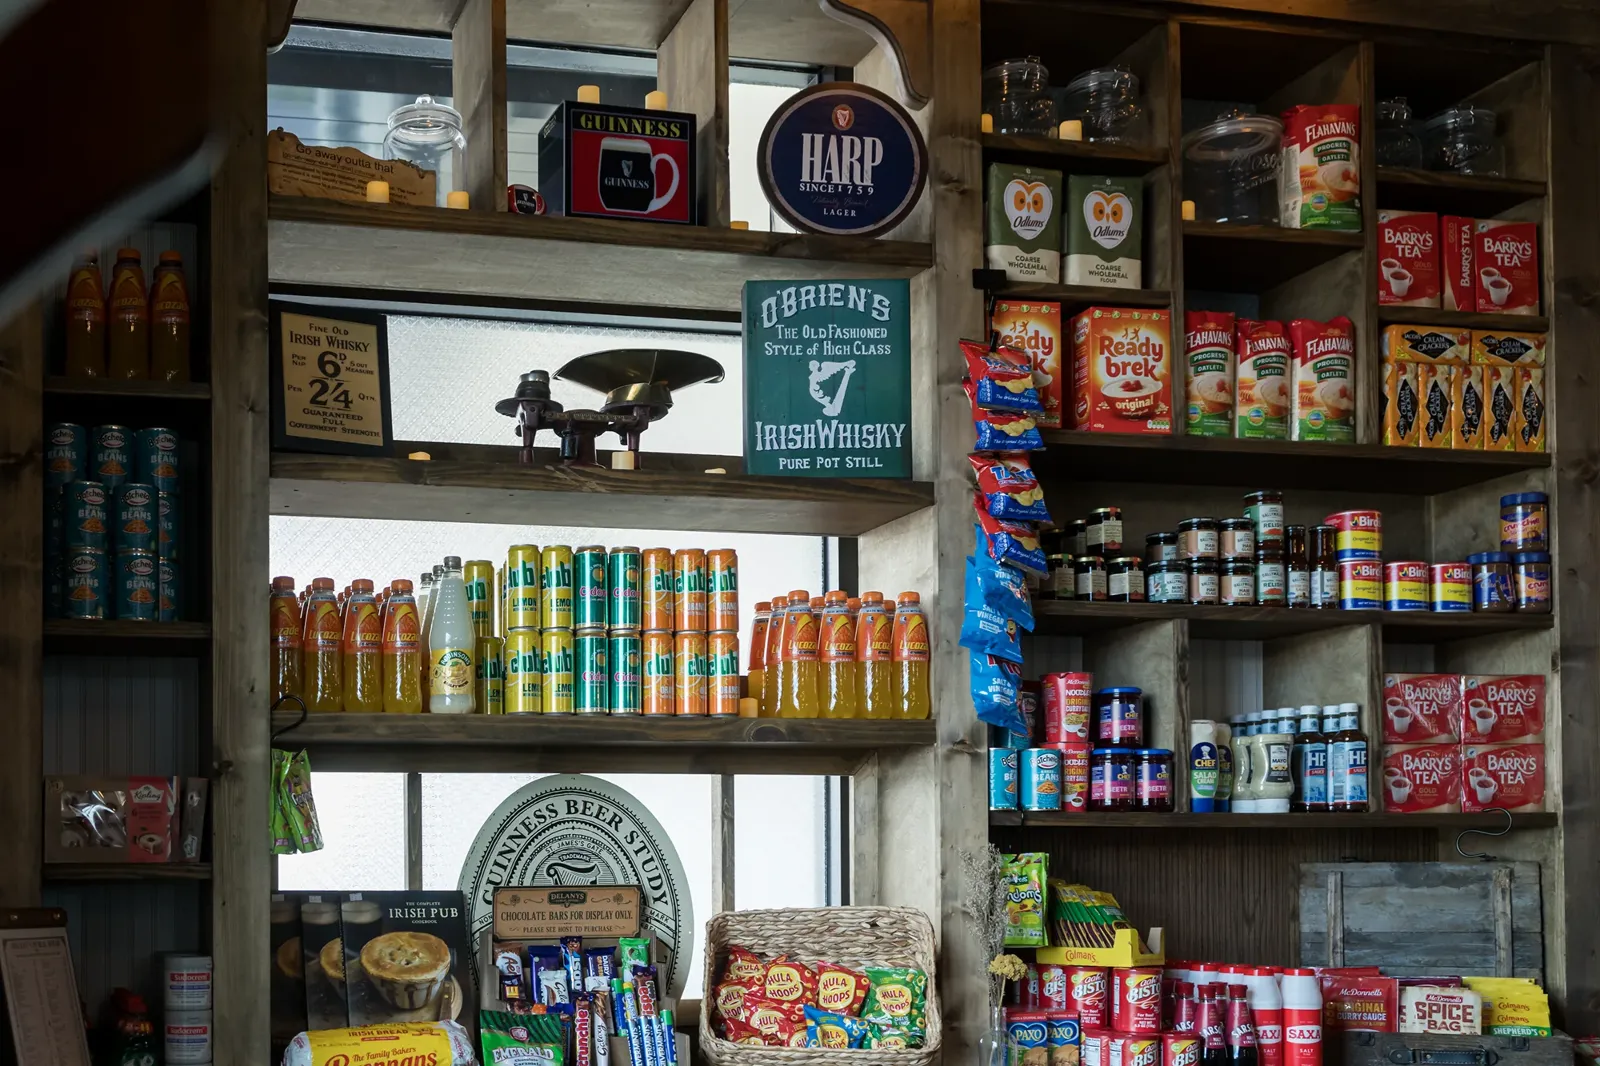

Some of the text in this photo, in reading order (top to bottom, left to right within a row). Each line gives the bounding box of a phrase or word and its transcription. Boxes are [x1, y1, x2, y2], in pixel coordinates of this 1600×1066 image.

[580, 113, 681, 138] GUINNESS
[295, 143, 312, 155] Go
[315, 150, 342, 163] away
[344, 157, 371, 169] outta
[374, 161, 394, 174] that
[801, 133, 883, 186] HARP
[604, 176, 650, 190] GUINNESS
[799, 183, 835, 193] SINCE
[824, 208, 857, 217] LAGER
[1013, 216, 1046, 229] Odlums
[1093, 226, 1126, 239] Odlums
[1384, 228, 1433, 250] BARRY'S
[1461, 225, 1470, 246] TEA
[1395, 245, 1422, 258] TEA
[1483, 237, 1533, 259] BARRY'S
[1007, 261, 1048, 272] WHOLEMEAL
[1015, 255, 1041, 264] COARSE
[1494, 253, 1521, 267] TEA
[1088, 270, 1129, 280] WHOLEMEAL
[1095, 264, 1121, 272] COARSE
[761, 283, 891, 328] O'BRIEN'S
[309, 322, 349, 335] FINE OLD
[776, 325, 799, 339] THE
[289, 331, 371, 352] IRISH WHISKY
[1185, 330, 1232, 349] FLAHAVAN'S
[1423, 335, 1446, 344] CREAM
[1500, 341, 1521, 349] CREAM
[765, 341, 892, 355] STYLE of HIGH CLASS
[1099, 335, 1164, 363] Ready
[1417, 342, 1451, 352] CRACKERS
[1495, 347, 1526, 356] CRACKERS
[345, 366, 375, 375] MEASURE
[1105, 356, 1161, 381] brek
[287, 384, 302, 392] PER
[1114, 395, 1154, 411] original
[303, 408, 364, 421] GUARANTEED
[289, 421, 338, 433] GOVERNMENT
[322, 418, 346, 426] FULL
[755, 418, 906, 451] IRISH WHISKY
[97, 453, 128, 463] BEANS
[779, 456, 883, 470] PURE POT STILL
[77, 509, 107, 520] BEANS
[121, 510, 152, 521] BEANS
[541, 560, 572, 590] club
[675, 565, 705, 593] club
[707, 565, 737, 593] club
[68, 578, 100, 587] BEANS
[126, 580, 156, 590] BEANS
[512, 597, 537, 607] LEMON
[977, 610, 1005, 626] VINEGAR
[510, 645, 542, 674] club
[542, 645, 572, 674] club
[707, 649, 739, 677] club
[988, 685, 1015, 697] VINEGAR
[1405, 683, 1452, 704] BARRY'S
[1487, 685, 1537, 705] BARRY'S
[1415, 701, 1439, 715] TEA
[1498, 702, 1524, 716] TEA
[1194, 758, 1217, 768] CHEF
[1403, 754, 1452, 774] BARRY'S
[1487, 754, 1537, 774] BARRY'S
[1193, 772, 1217, 780] SALAD
[1413, 771, 1440, 785] TEA
[1498, 771, 1525, 785] TEA
[133, 790, 162, 801] Kipling
[482, 799, 669, 906] GUINNESS BEER STUDY
[586, 841, 606, 854] GATE
[559, 852, 592, 863] TRADEMARK
[550, 892, 586, 901] DELANYS
[1007, 889, 1042, 903] ndoms
[388, 907, 459, 919] IRISH PUB
[501, 910, 633, 922] CHOCOLATE BARS FOR DISPLAY ONLY.
[650, 908, 670, 923] MARK
[1065, 949, 1097, 963] Colman's
[736, 964, 761, 972] HULA
[173, 973, 209, 981] Sudocrem
[767, 973, 793, 985] HULA
[822, 977, 848, 991] HULA
[769, 984, 800, 998] HOOPS
[823, 990, 850, 1004] HOOPS
[882, 990, 905, 999] HULA
[1073, 981, 1107, 1000] BISTO
[1127, 983, 1161, 1001] BISTO
[1338, 987, 1383, 998] McDonnells
[639, 986, 654, 1016] ispa
[721, 991, 741, 1005] HULA
[1426, 994, 1463, 1003] McDonnells
[882, 999, 910, 1013] HOOPS
[1414, 1001, 1475, 1023] SPICE
[1498, 1001, 1530, 1011] Colman's
[757, 1016, 778, 1027] HULA
[1337, 1012, 1387, 1021] CURRY SAUCE
[1497, 1014, 1530, 1023] Colman's
[1427, 1020, 1462, 1031] BAG
[1493, 1027, 1538, 1036] SHEPHERD'S
[349, 1029, 375, 1037] IRISH
[576, 1009, 590, 1066] crunchie
[1015, 1029, 1043, 1041] PAXO
[1288, 1028, 1321, 1039] SAXA
[597, 1024, 608, 1057] Galaxy
[352, 1047, 416, 1062] The Family Bakers
[492, 1047, 554, 1063] EMERALD
